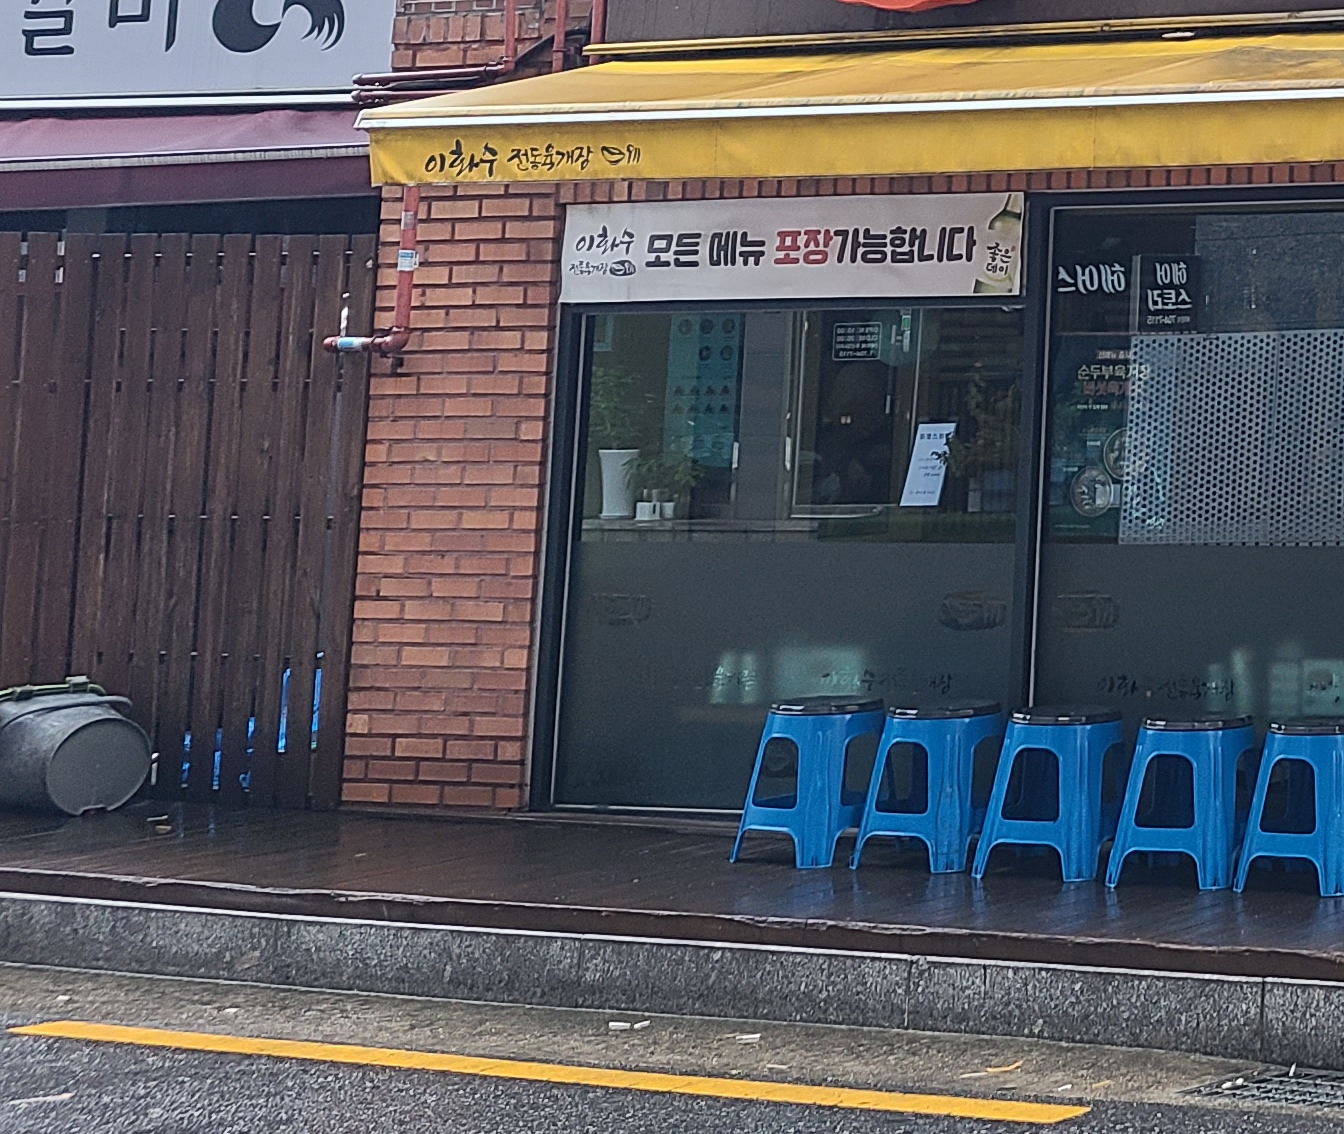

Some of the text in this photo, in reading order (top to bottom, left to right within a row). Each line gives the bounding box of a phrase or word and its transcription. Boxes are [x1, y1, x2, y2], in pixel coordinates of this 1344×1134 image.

[424, 137, 594, 178] 이화수 전통육개장
[575, 224, 635, 256] 이화수
[644, 225, 977, 269] 모든 메뉴 포장가능합니다
